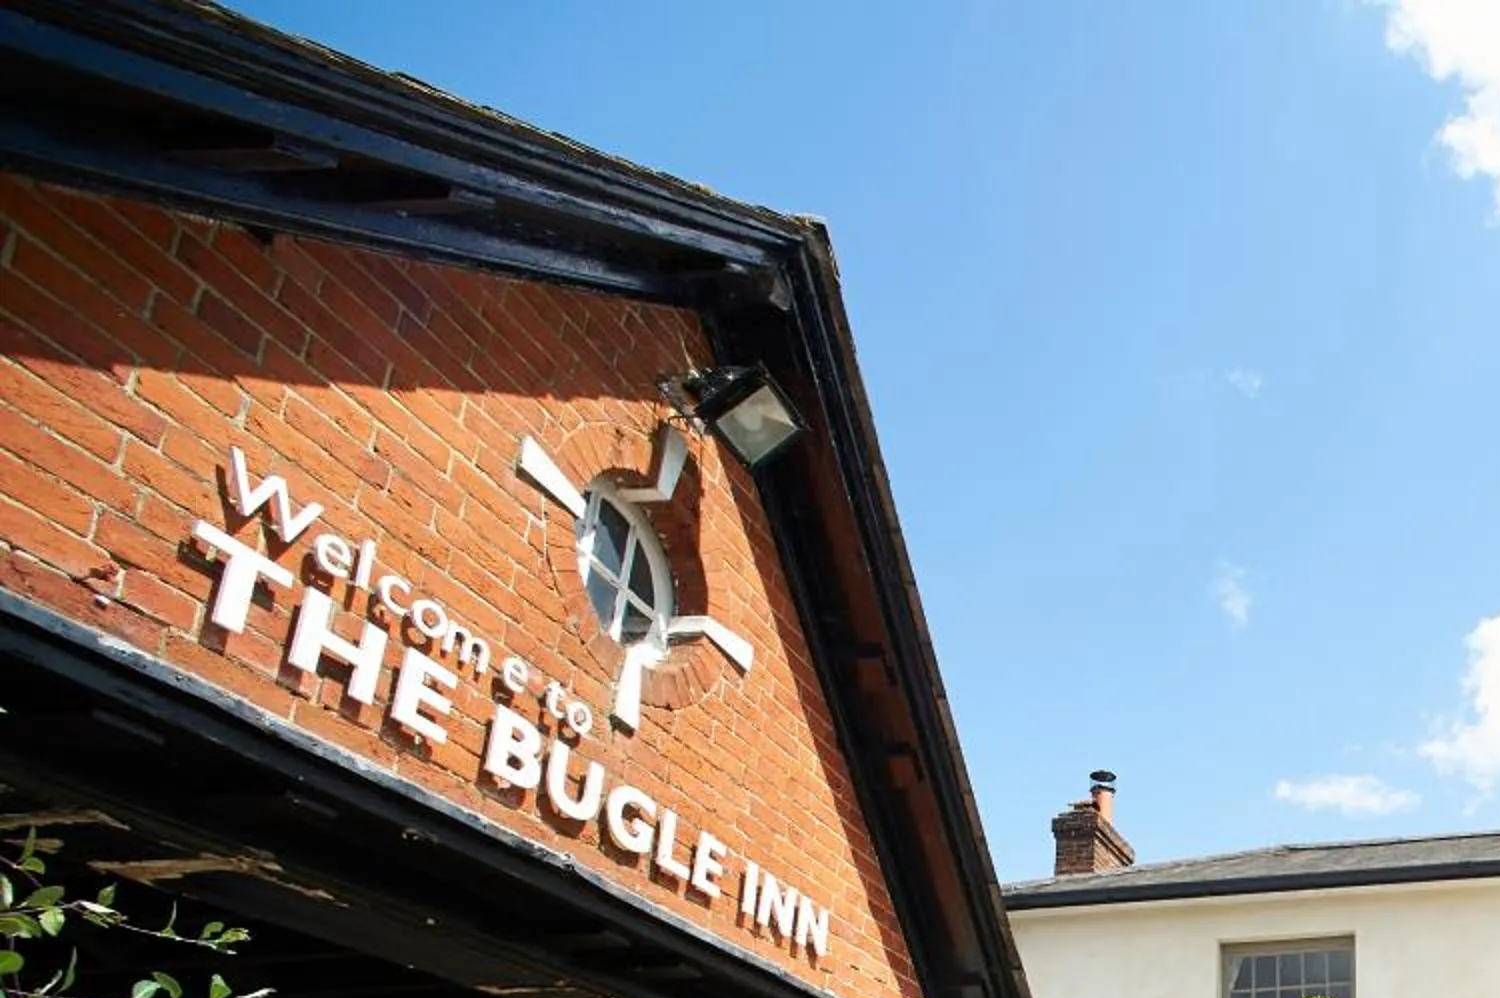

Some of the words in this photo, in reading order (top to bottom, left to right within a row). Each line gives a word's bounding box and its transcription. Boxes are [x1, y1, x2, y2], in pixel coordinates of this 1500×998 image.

[193, 519, 457, 744] THE
[484, 703, 728, 899] BUGLE
[741, 859, 829, 957] INN
[230, 446, 529, 694] Welcome
[545, 678, 593, 736] to
